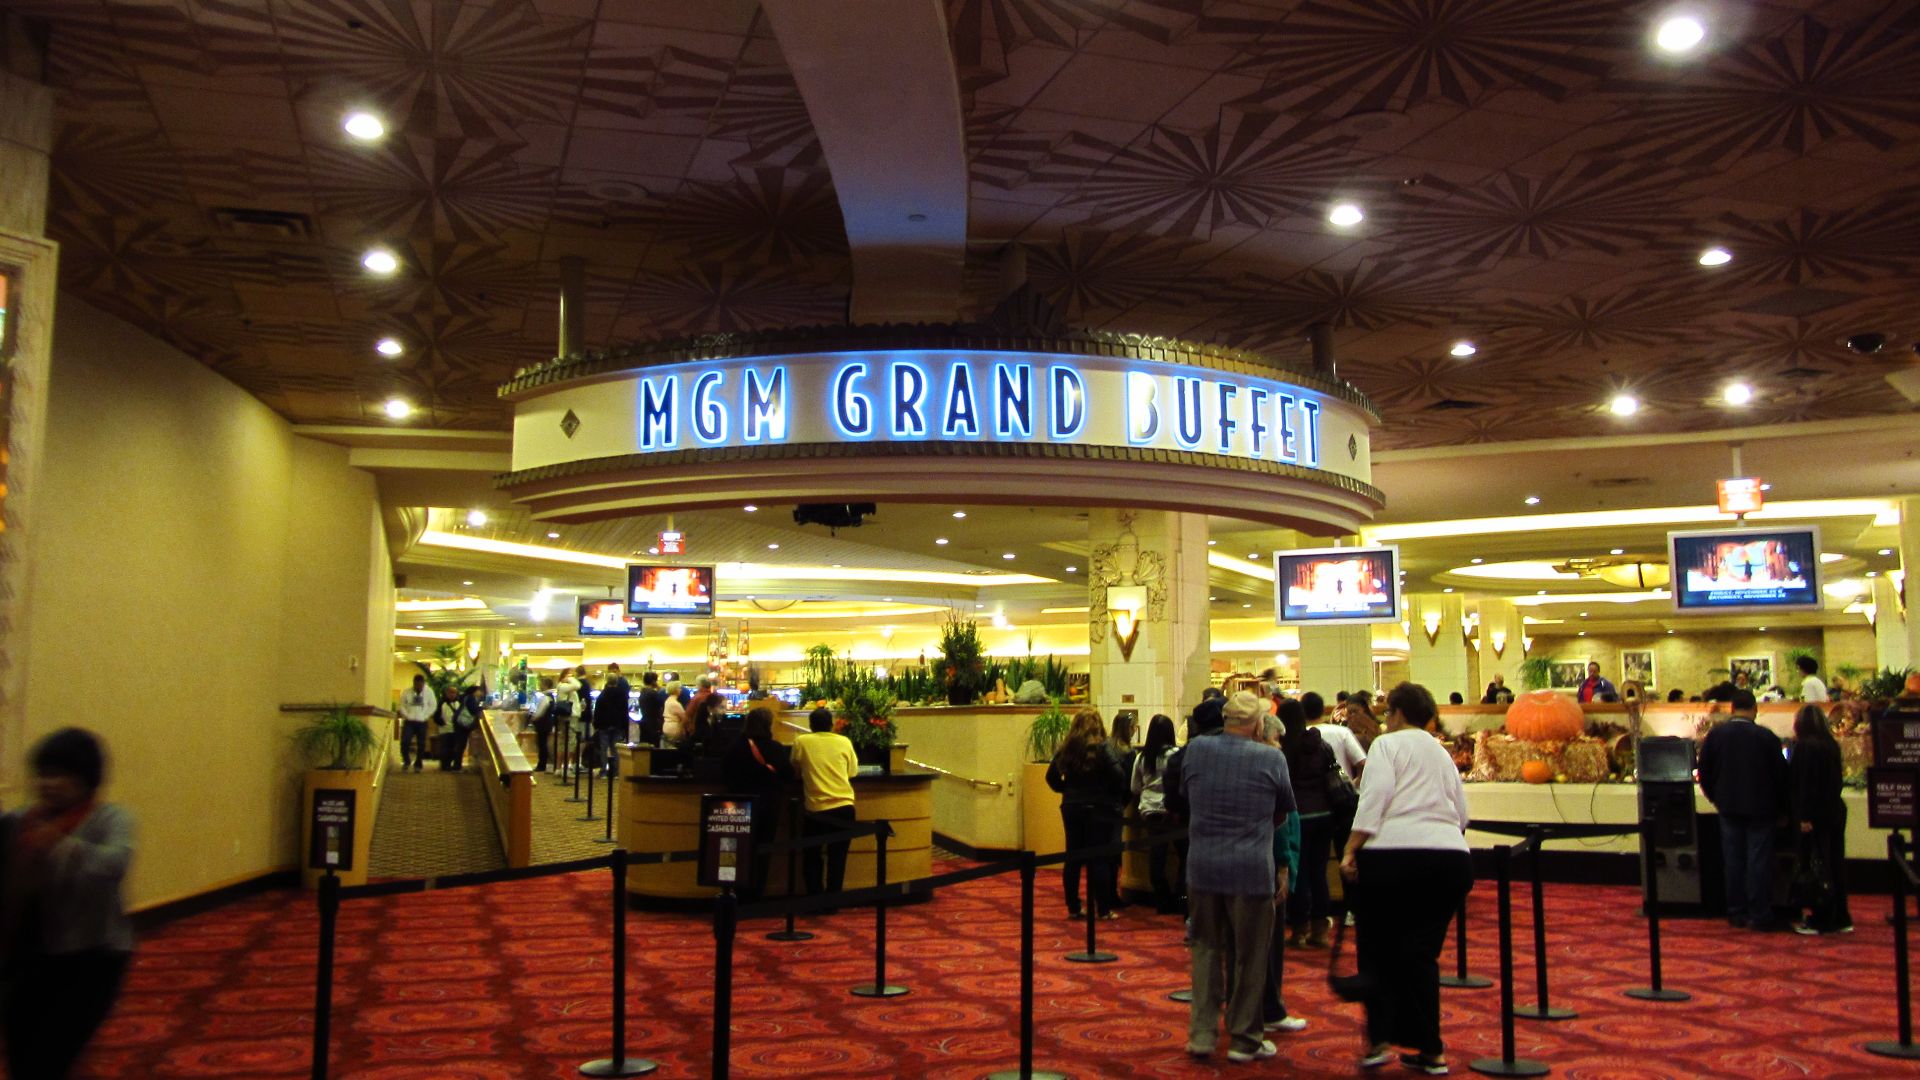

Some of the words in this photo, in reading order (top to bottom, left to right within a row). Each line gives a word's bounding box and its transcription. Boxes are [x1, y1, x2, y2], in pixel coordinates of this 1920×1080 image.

[640, 366, 786, 449] MGM
[833, 361, 1086, 438] GRAND
[1126, 371, 1320, 469] BUFFET
[1876, 783, 1894, 792] SELF
[1896, 783, 1912, 792] PAY
[707, 824, 735, 833] CASHIER
[736, 825, 750, 833] LINE
